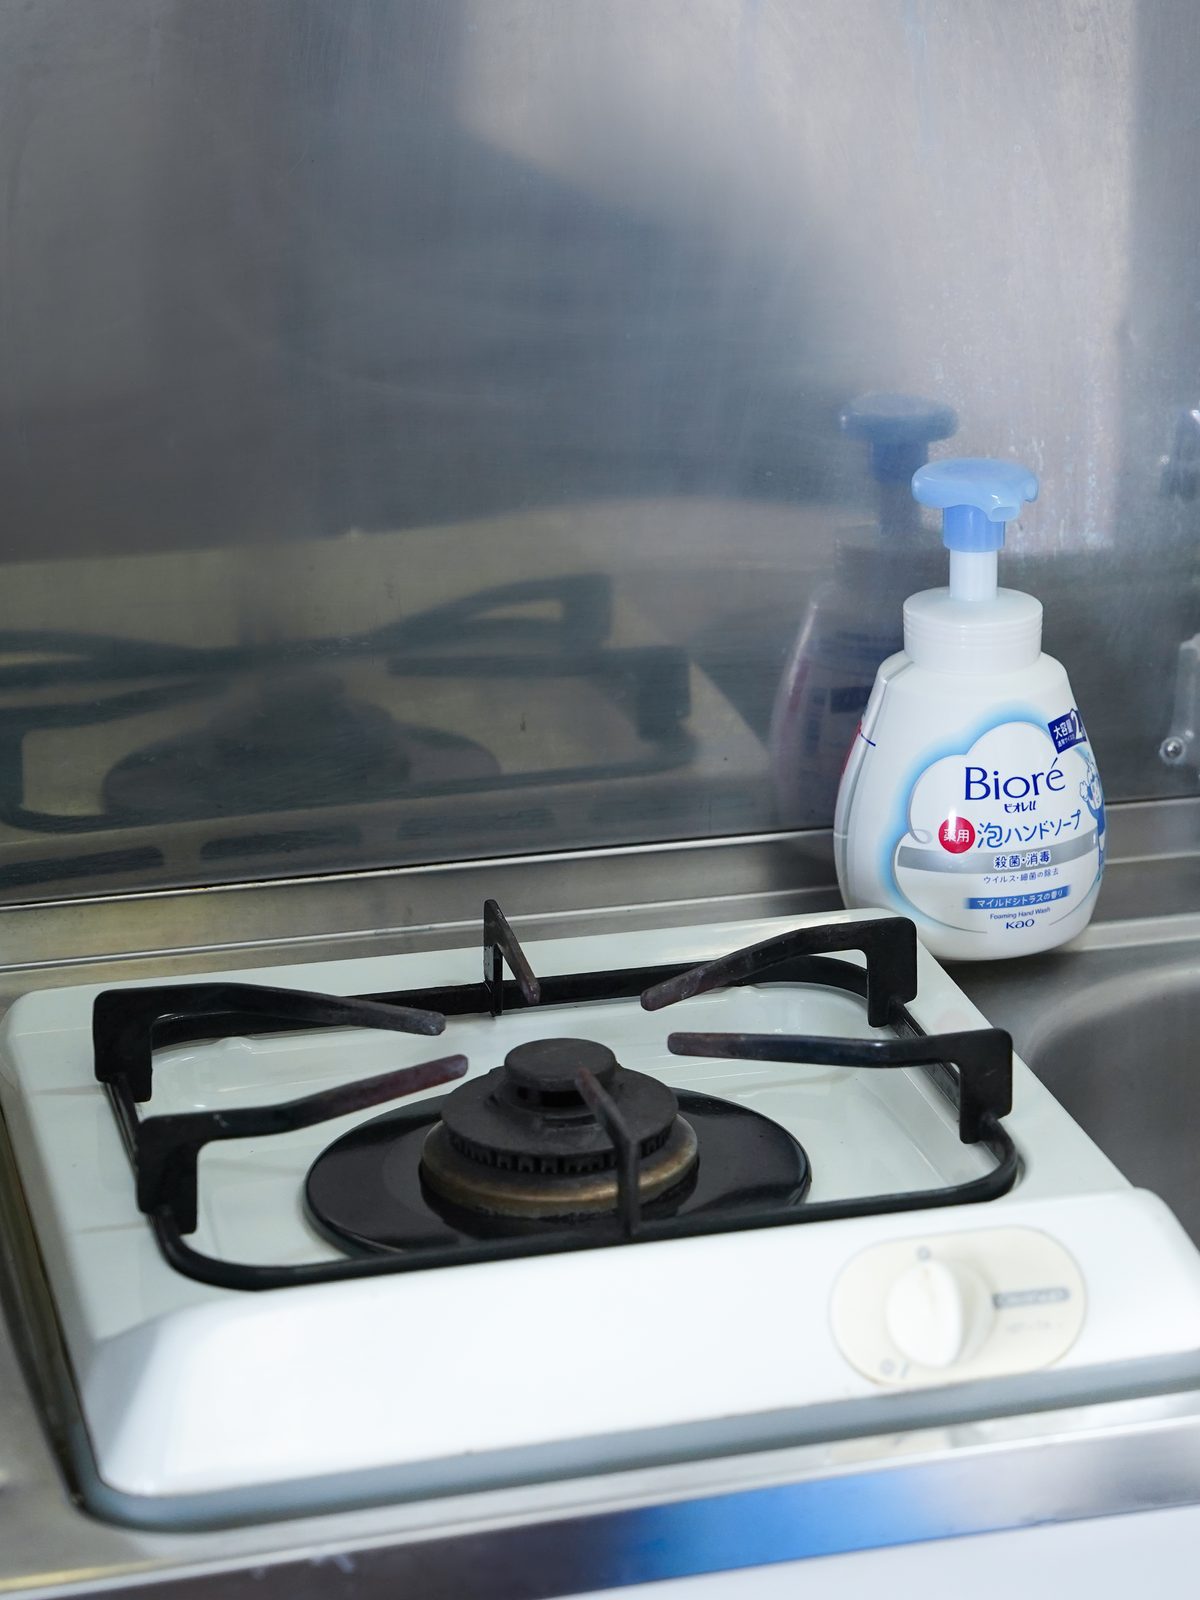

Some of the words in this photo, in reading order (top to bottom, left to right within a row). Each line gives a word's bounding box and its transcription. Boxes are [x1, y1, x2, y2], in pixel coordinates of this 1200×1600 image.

[965, 757, 1066, 800] Bioré
[977, 810, 1082, 848] 泡ハンドソープ
[994, 851, 1051, 868] 殺菌・消毒
[1018, 910, 1034, 918] Hand
[1035, 907, 1050, 915] Wash
